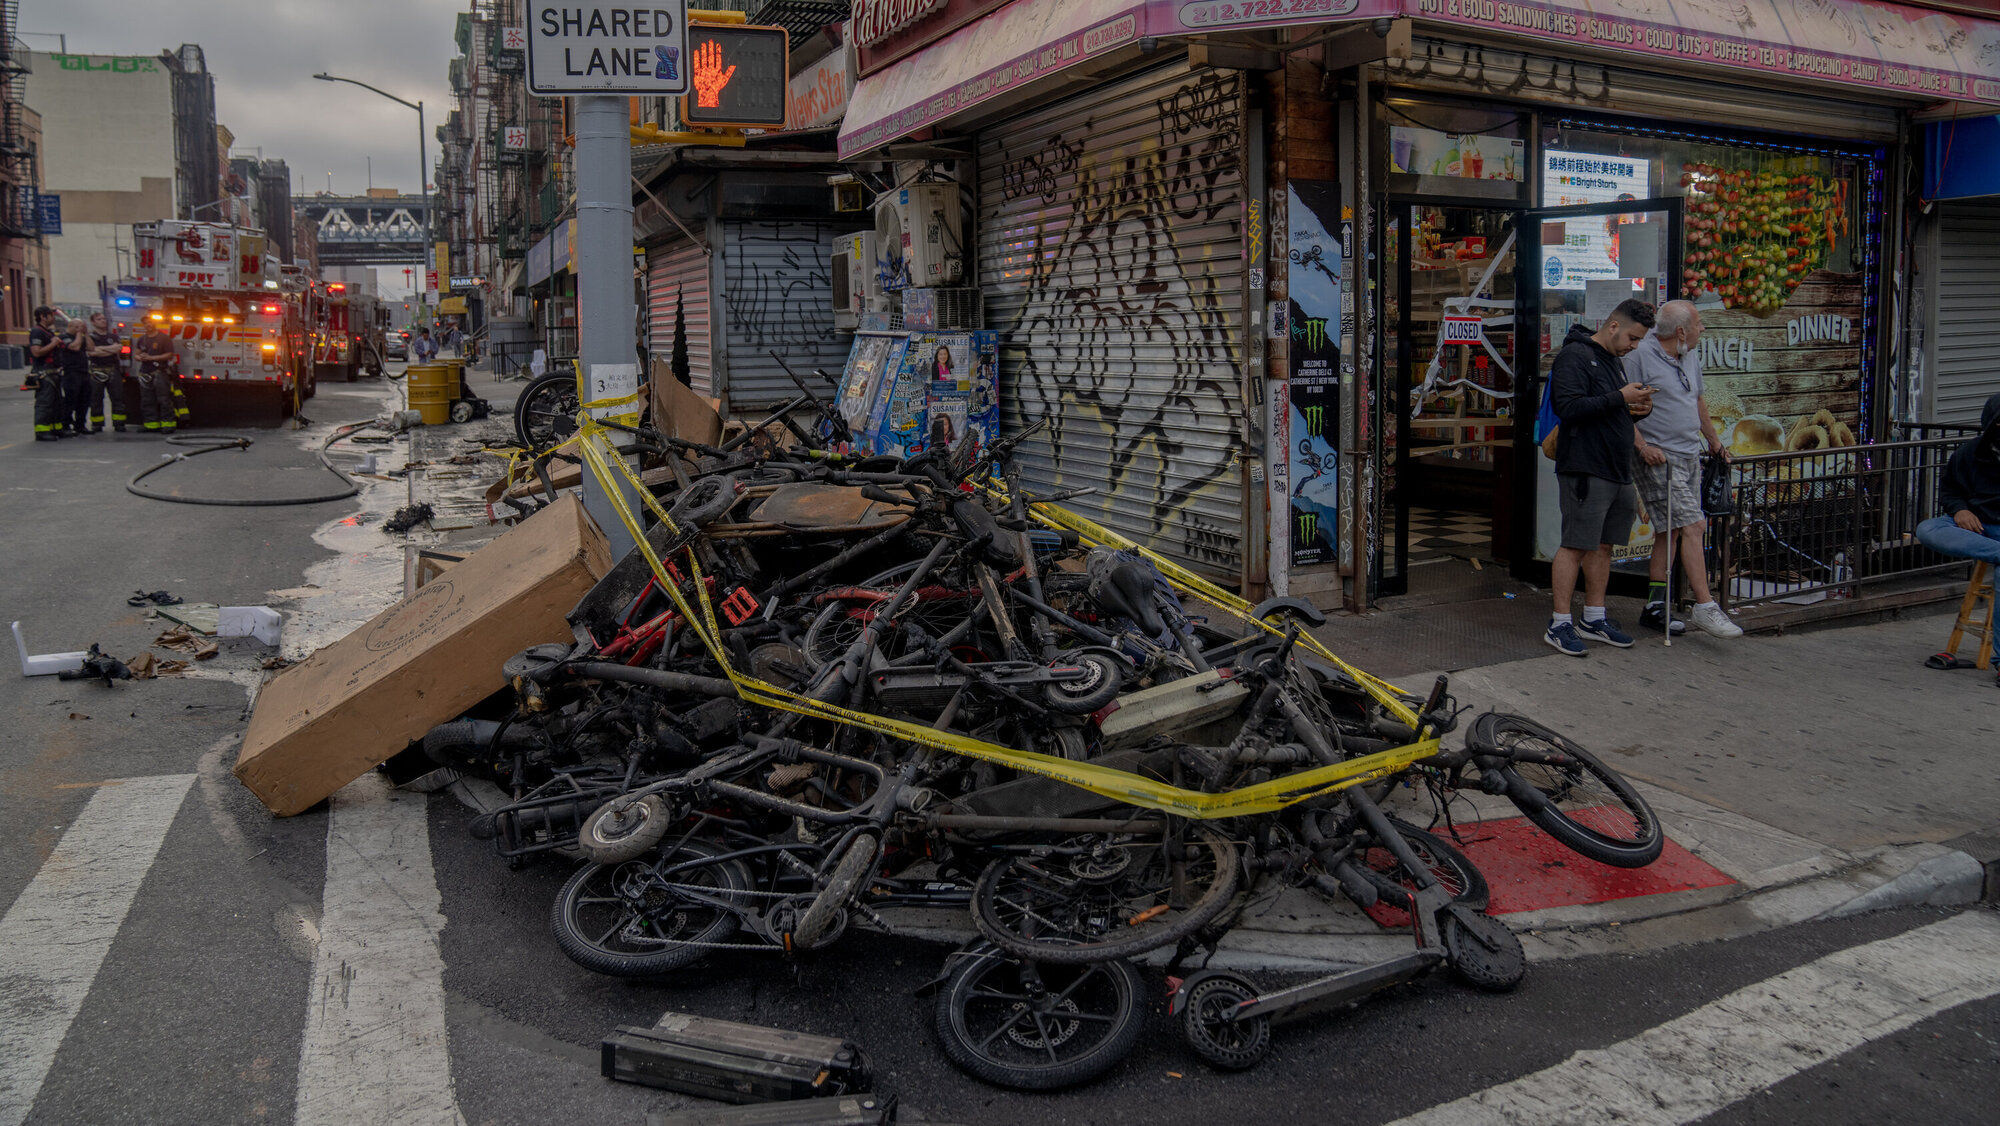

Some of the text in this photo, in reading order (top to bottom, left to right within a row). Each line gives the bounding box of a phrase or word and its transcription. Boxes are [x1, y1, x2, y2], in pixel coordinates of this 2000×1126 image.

[541, 8, 673, 38] SHARED
[1419, 0, 1444, 13] HOT
[1449, 0, 1459, 16] &
[1463, 2, 1495, 21] COLD
[1499, 4, 1577, 36] SANDWICHES
[1590, 20, 1633, 45] SALADS
[1645, 29, 1673, 51] COLD
[1676, 33, 1701, 55] CUTS
[1759, 48, 1777, 67] TEA
[1786, 52, 1841, 77] CAPPUCCINO
[1850, 62, 1879, 81] CANDY
[1887, 68, 1910, 86] SODA
[1919, 71, 1941, 91] JUICE
[1949, 77, 1969, 96] MILK
[565, 48, 652, 76] LANE
[886, 117, 900, 136] SALADS
[903, 110, 914, 128] COLD
[949, 91, 957, 109] TEA
[961, 76, 991, 104] CAPPUCCINO
[996, 65, 1013, 90] CANDY
[1019, 58, 1034, 79] SODA
[1040, 47, 1057, 70] JUICE
[1062, 38, 1079, 60] MILK
[788, 87, 819, 130] News
[1560, 175, 1618, 189] NYC Bright Starts
[179, 271, 215, 283] FDNY
[451, 279, 472, 288] PARK
[169, 325, 228, 341] FDNY
[1447, 322, 1479, 339] CLOSED
[1787, 313, 1851, 347] DINNER
[934, 337, 956, 346] SUSAN
[956, 338, 969, 346] LEE
[1302, 359, 1327, 368] WELCOME TO
[1297, 368, 1318, 377] CATHERINE
[1318, 368, 1327, 376] DELI
[598, 379, 606, 393] 3
[1290, 377, 1310, 385] CATHERINE
[1310, 377, 1316, 385] ST
[1318, 376, 1327, 385] NEW
[932, 404, 966, 413] SUSAN LEE
[1294, 548, 1322, 556] MONSTER
